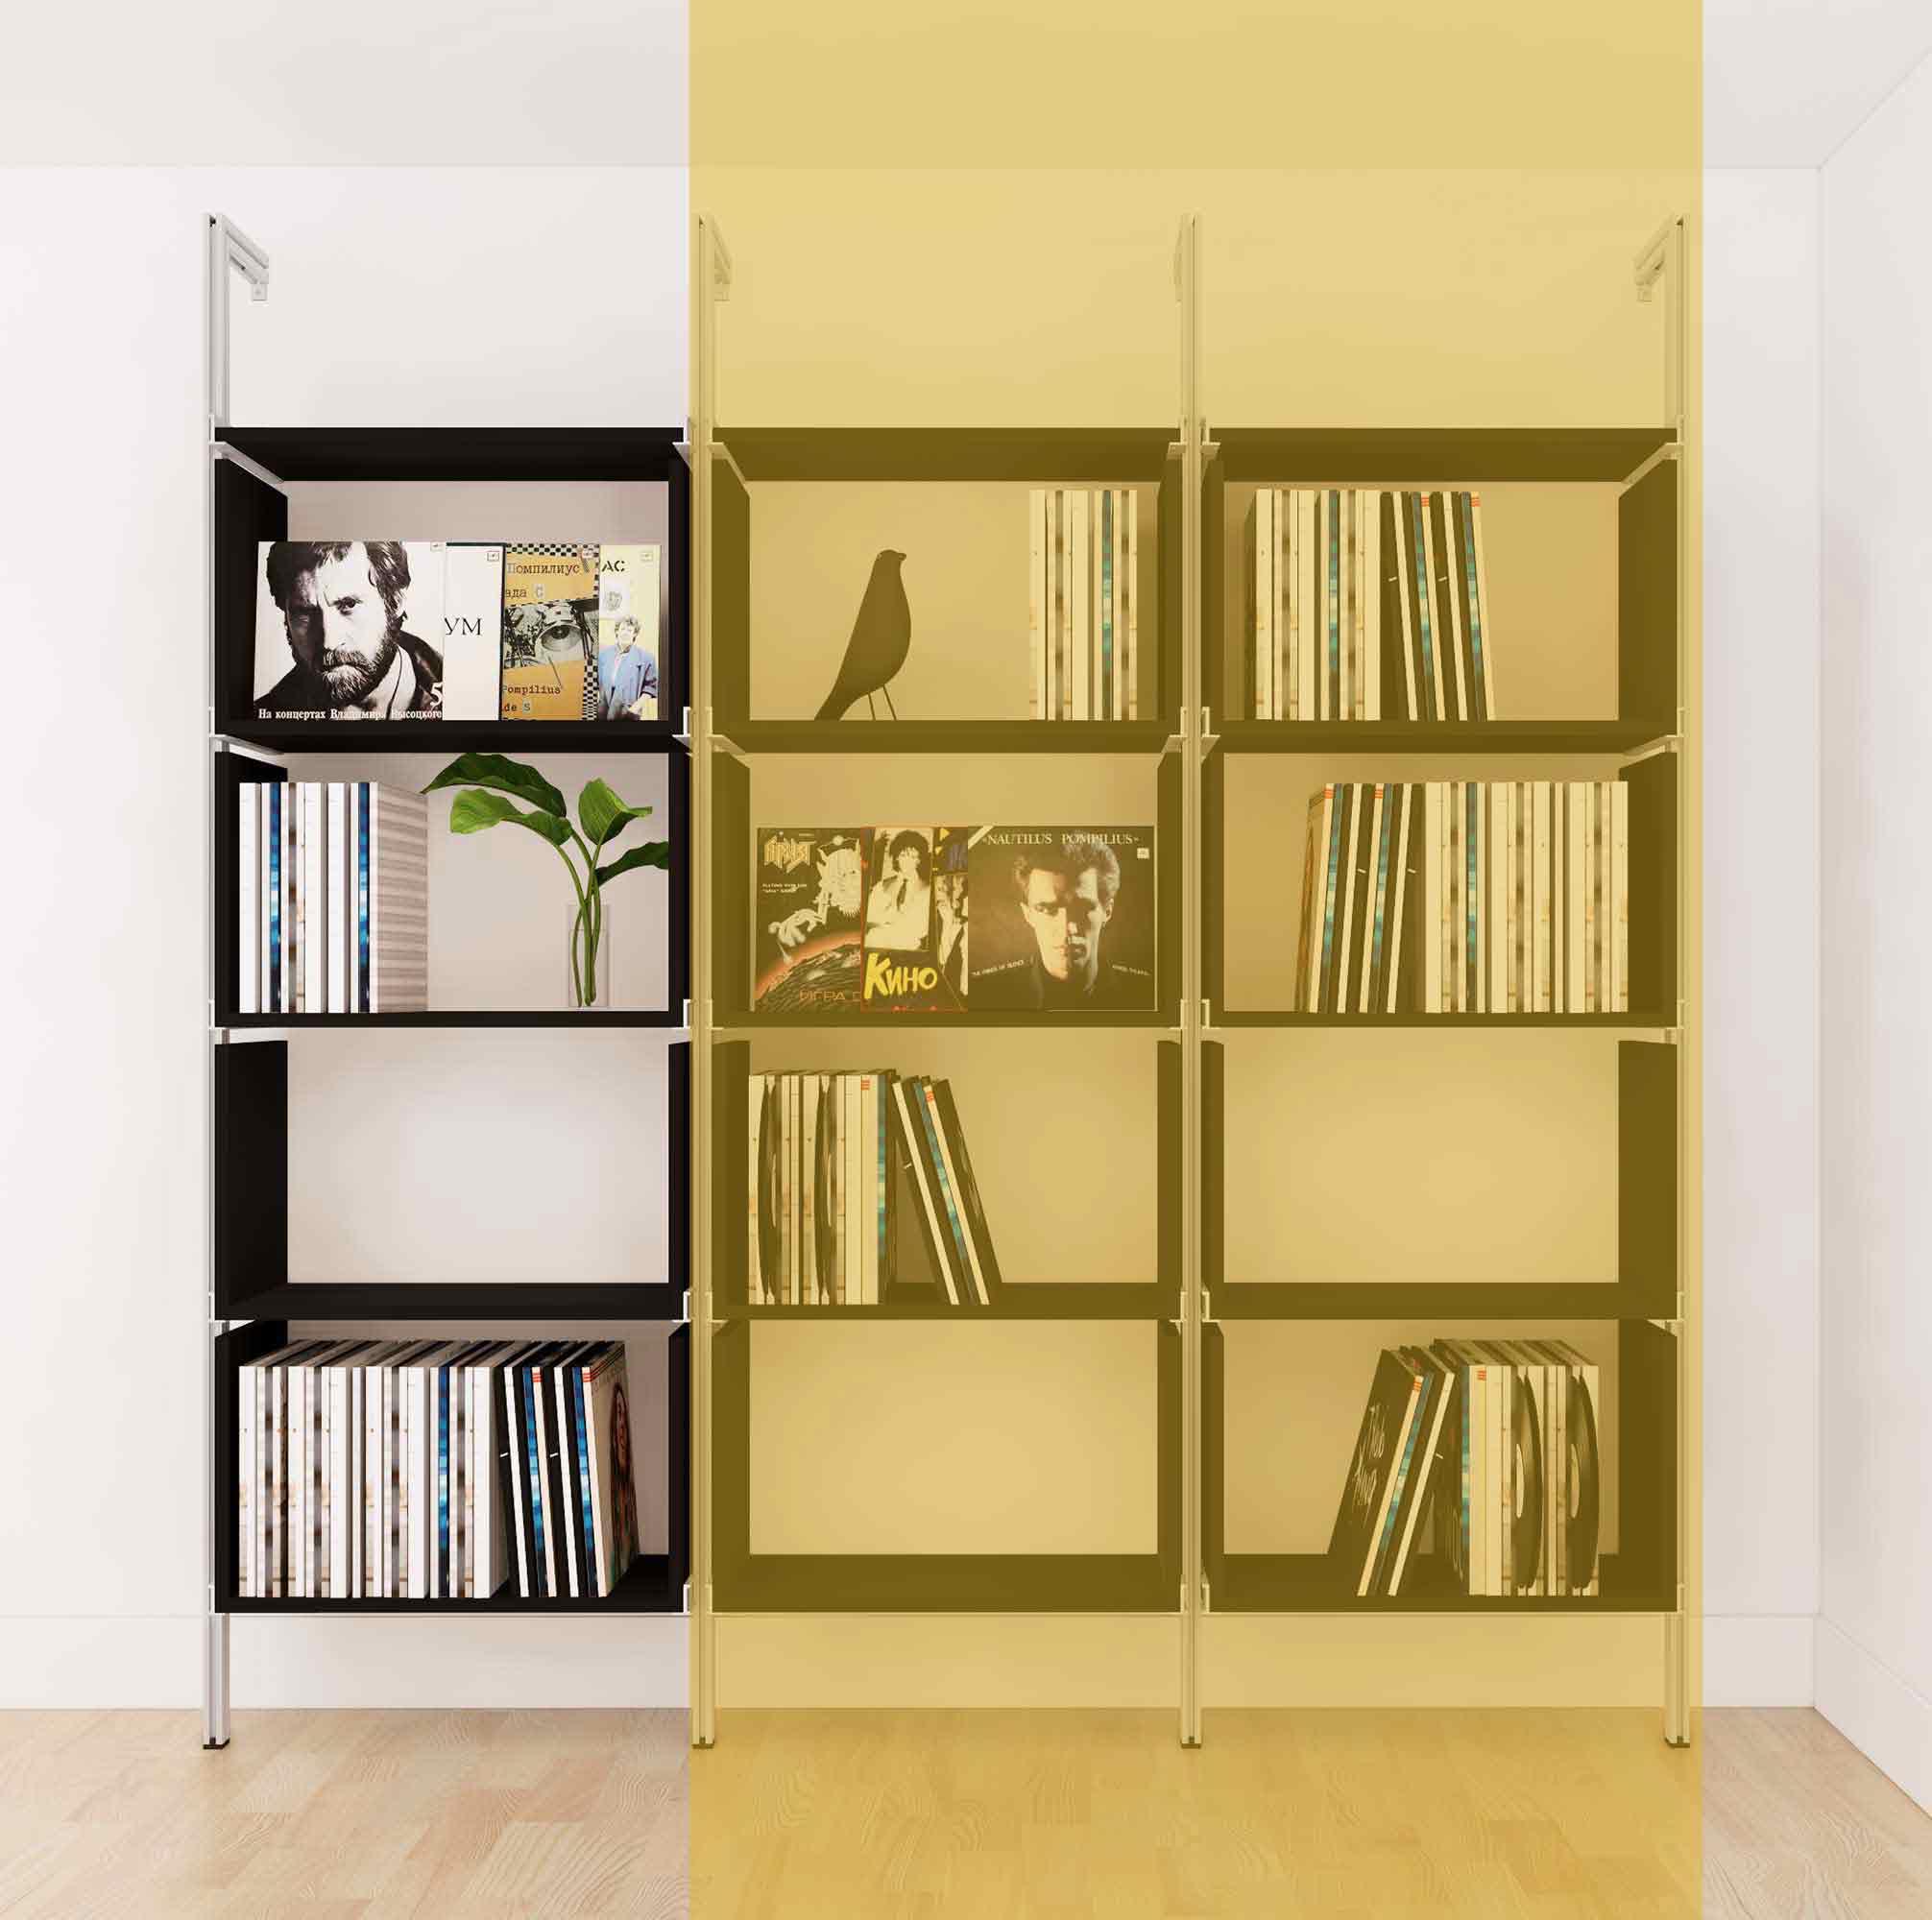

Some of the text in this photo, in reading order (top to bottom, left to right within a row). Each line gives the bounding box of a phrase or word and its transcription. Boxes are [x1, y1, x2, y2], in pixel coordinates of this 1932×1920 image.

[506, 563, 580, 576] Помпилиус
[444, 617, 483, 636] УМ
[430, 683, 443, 708] 5
[258, 708, 272, 719] На
[276, 709, 326, 721] концертах
